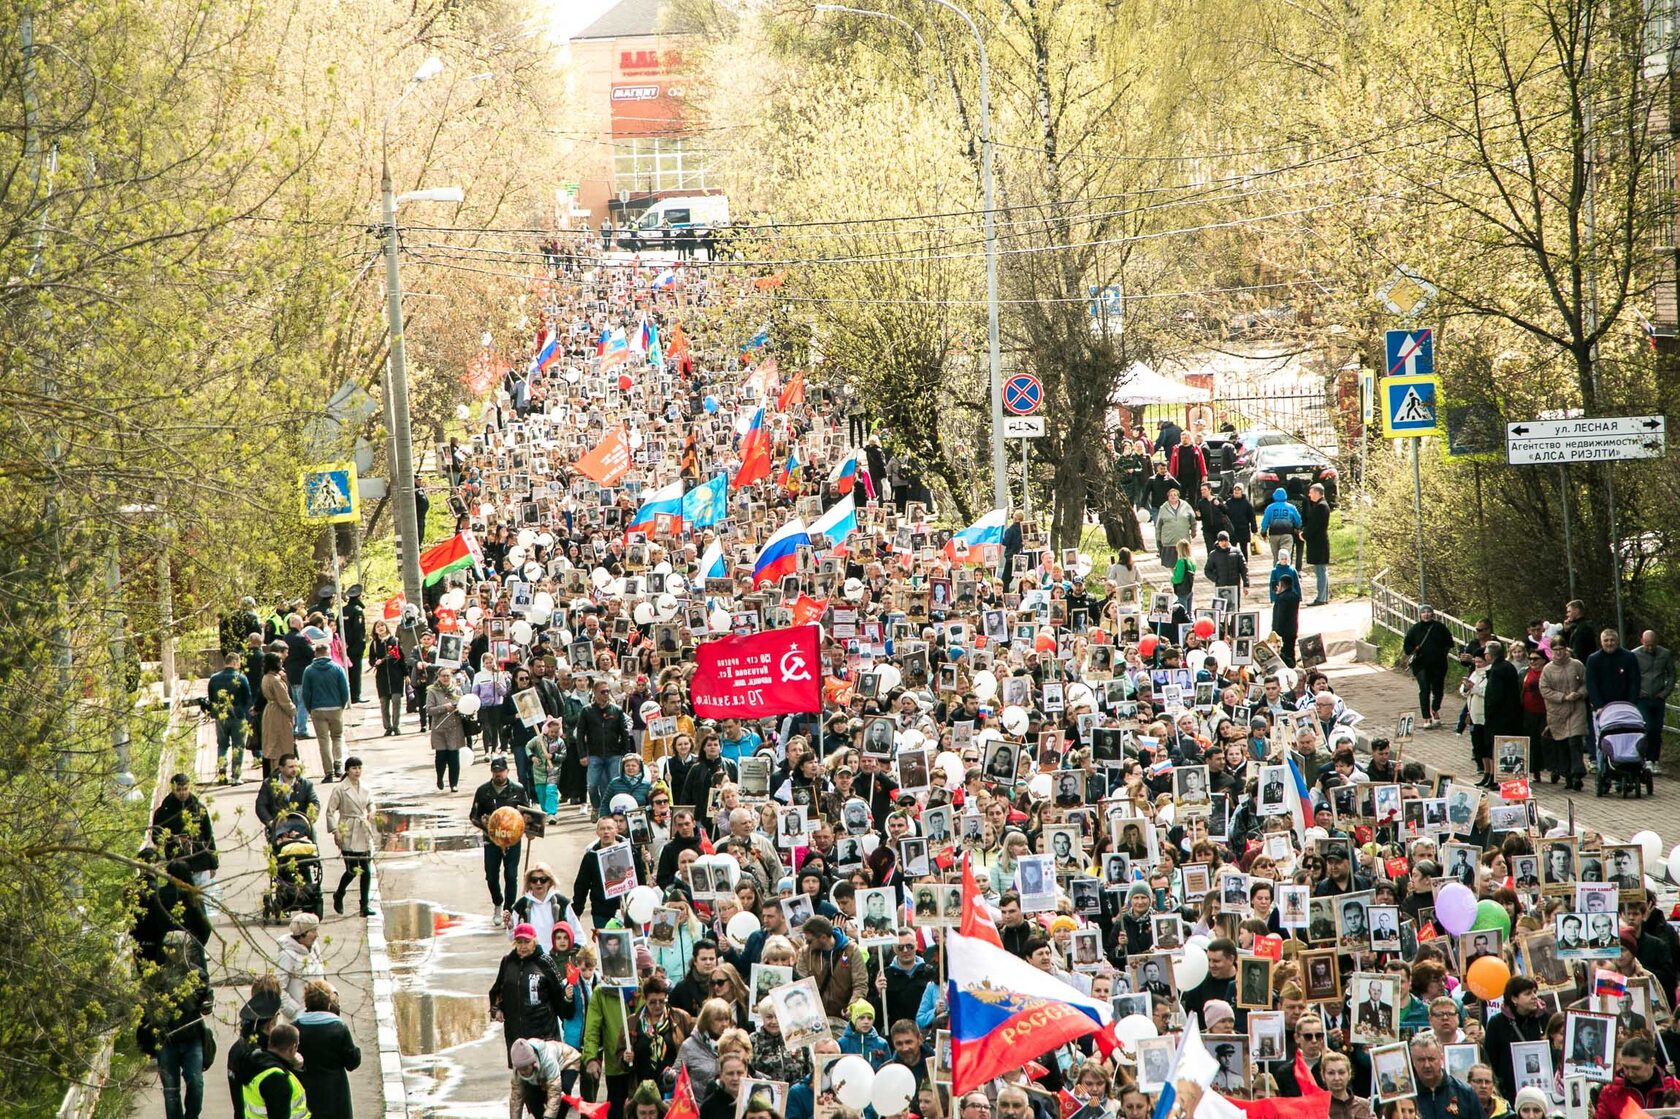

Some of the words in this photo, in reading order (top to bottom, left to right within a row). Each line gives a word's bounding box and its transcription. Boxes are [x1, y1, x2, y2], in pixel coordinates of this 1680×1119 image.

[1555, 425, 1571, 436] ул.
[1574, 422, 1618, 433] ЛЕСНАЯ
[1511, 441, 1561, 451] Агентство
[1565, 438, 1639, 449] недвижимости
